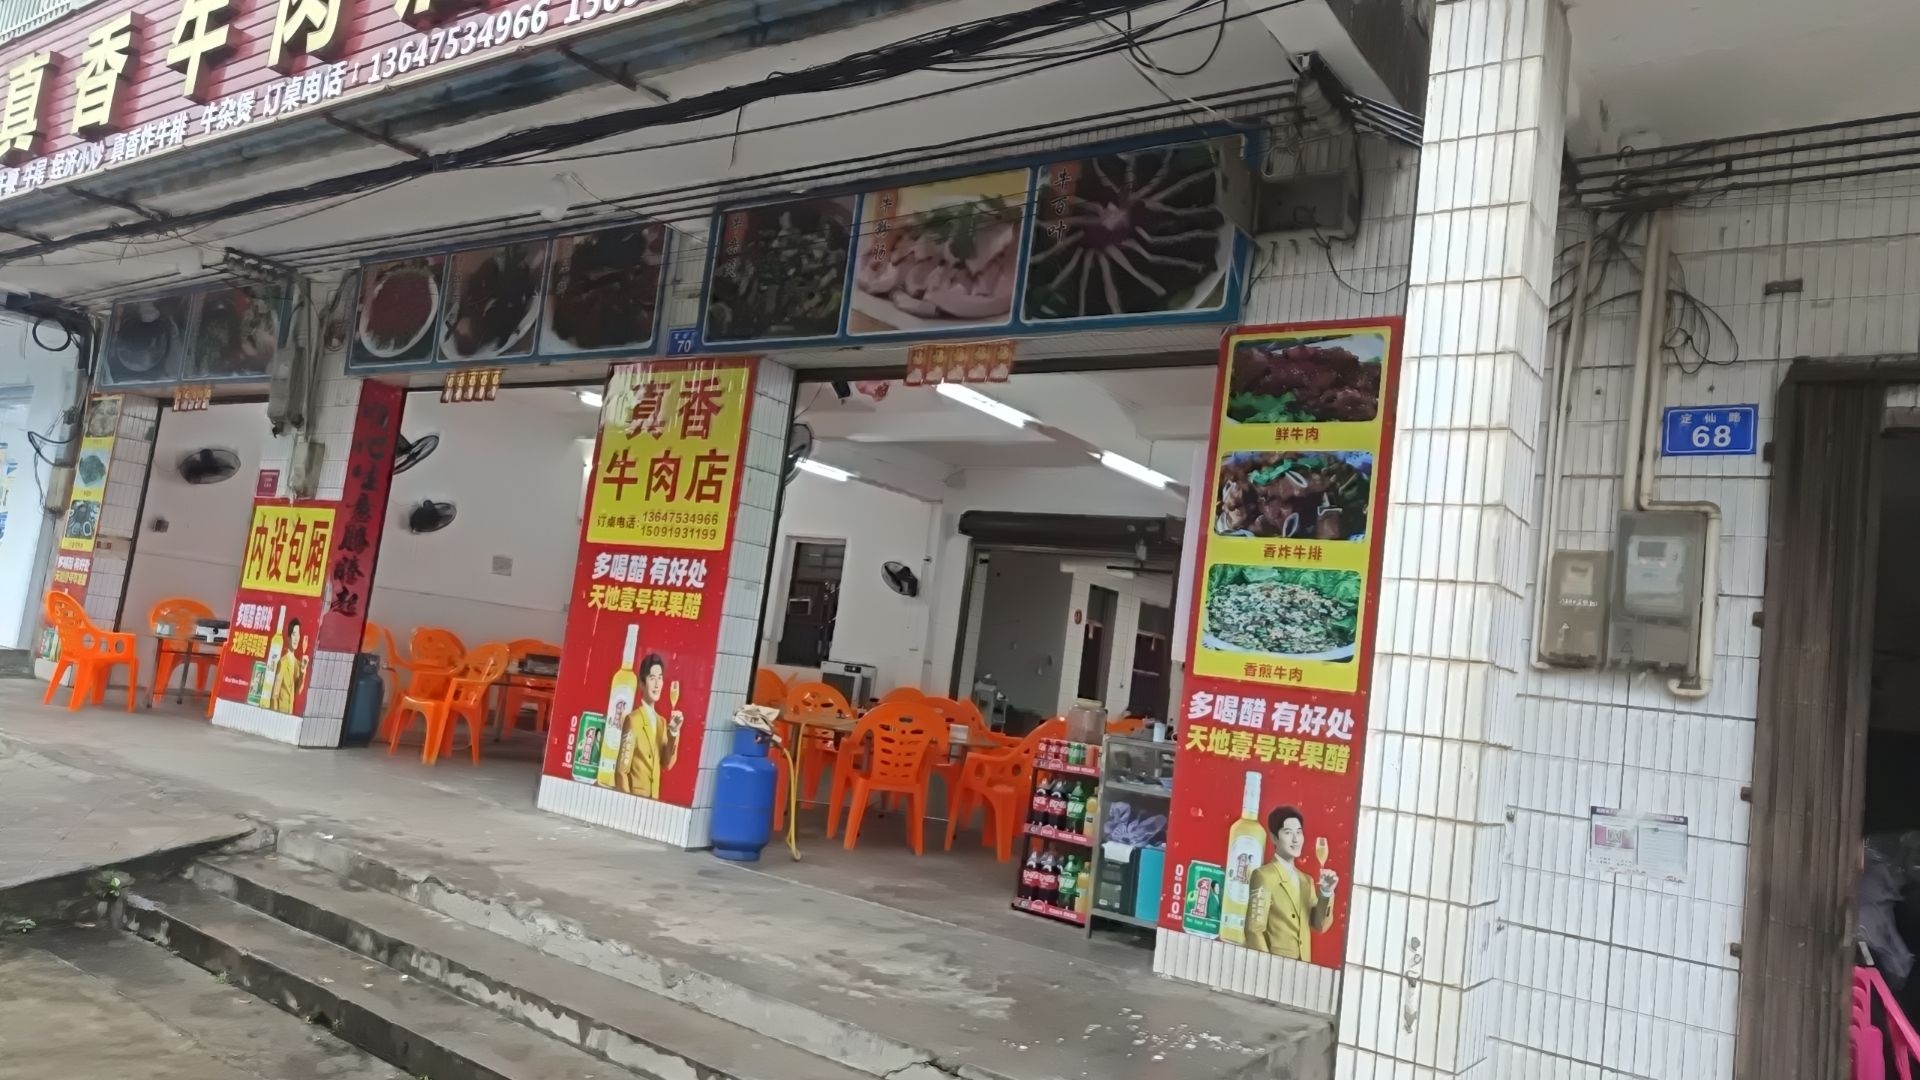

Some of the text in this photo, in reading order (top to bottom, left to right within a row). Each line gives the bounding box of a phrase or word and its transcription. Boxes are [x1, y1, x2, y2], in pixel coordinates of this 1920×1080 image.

[0, 0, 430, 156] 真香牛肉
[111, 112, 188, 164] 真香炸牛排
[368, 3, 549, 84] 13647534966
[677, 340, 691, 352] 70
[626, 376, 722, 440] 真香
[1275, 426, 1319, 442] 鲜牛肉
[1692, 425, 1731, 448] 68
[603, 447, 729, 504] 牛肉店
[641, 525, 717, 541] 15091931199
[642, 511, 718, 526] 13647534966
[248, 516, 330, 588] 内设包厢
[592, 552, 708, 588] 多喝醋 有好处
[1263, 544, 1322, 561] 香炸牛排
[588, 584, 702, 620] 天地壹号苹果醋
[1243, 662, 1303, 682] 香煎牛肉
[1188, 691, 1355, 741] 多喝醋 有好处
[1185, 724, 1351, 774] 天地壹号苹果醋
